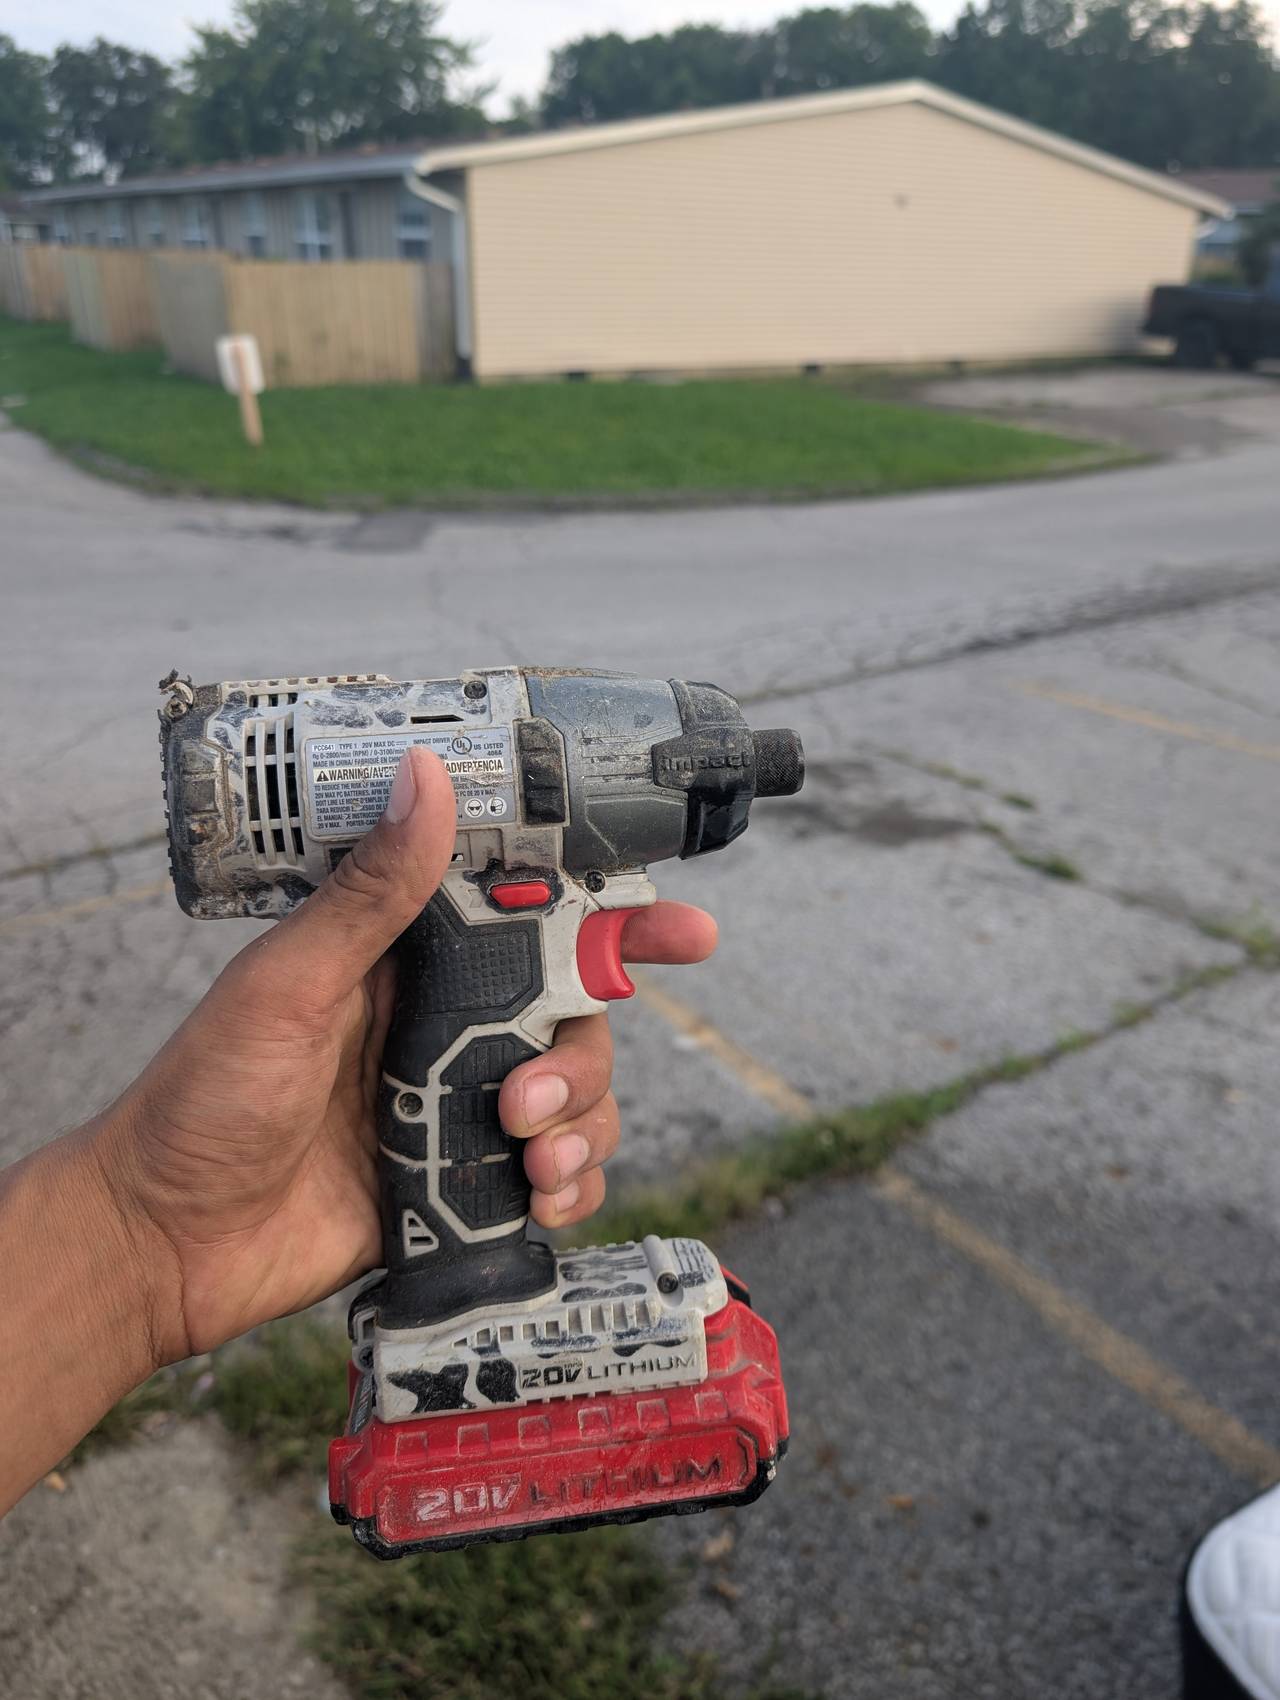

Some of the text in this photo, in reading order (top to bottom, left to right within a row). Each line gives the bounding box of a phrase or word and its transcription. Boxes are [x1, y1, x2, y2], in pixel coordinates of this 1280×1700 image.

[313, 744, 335, 752] PCC641
[484, 742, 504, 750] LISTED
[313, 760, 328, 768] MADE
[521, 1353, 697, 1390] 20V LITHIUM
[414, 1455, 723, 1523] 20V LITHIUM
